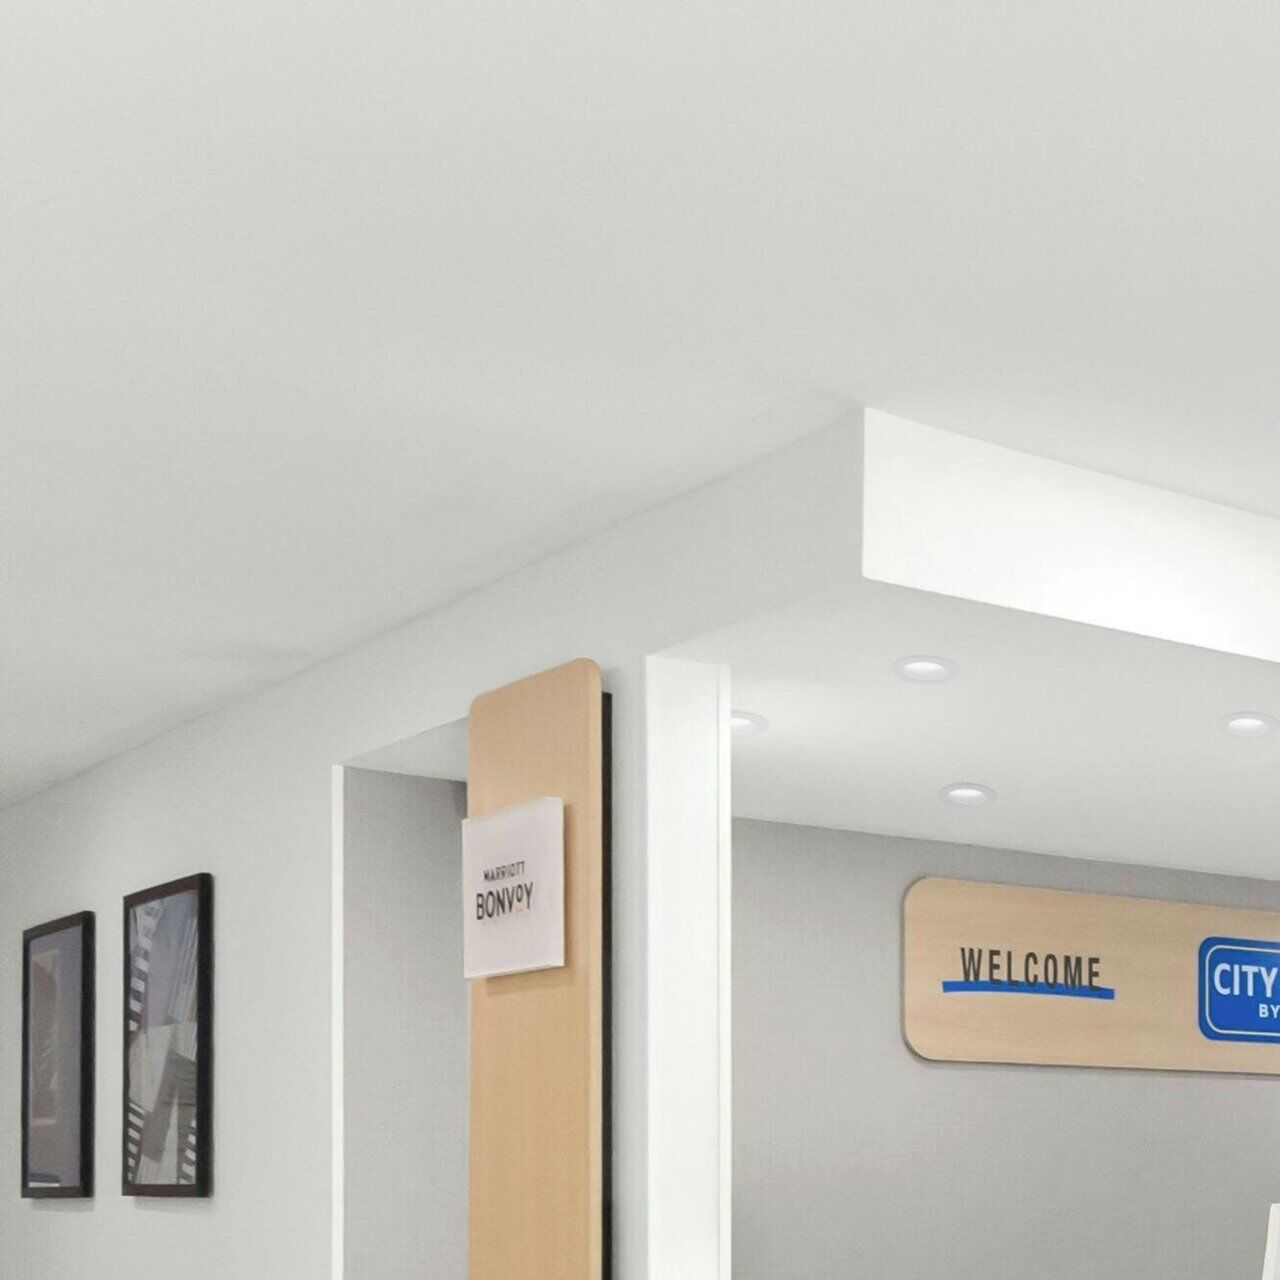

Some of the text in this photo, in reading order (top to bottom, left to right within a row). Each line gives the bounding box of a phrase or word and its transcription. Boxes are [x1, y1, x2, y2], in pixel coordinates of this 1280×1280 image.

[483, 861, 526, 882] MARRIOTT
[475, 881, 534, 920] BONVOY
[960, 947, 1101, 992] WELCOME
[1212, 962, 1279, 999] CITY
[1257, 1002, 1280, 1019] BY
